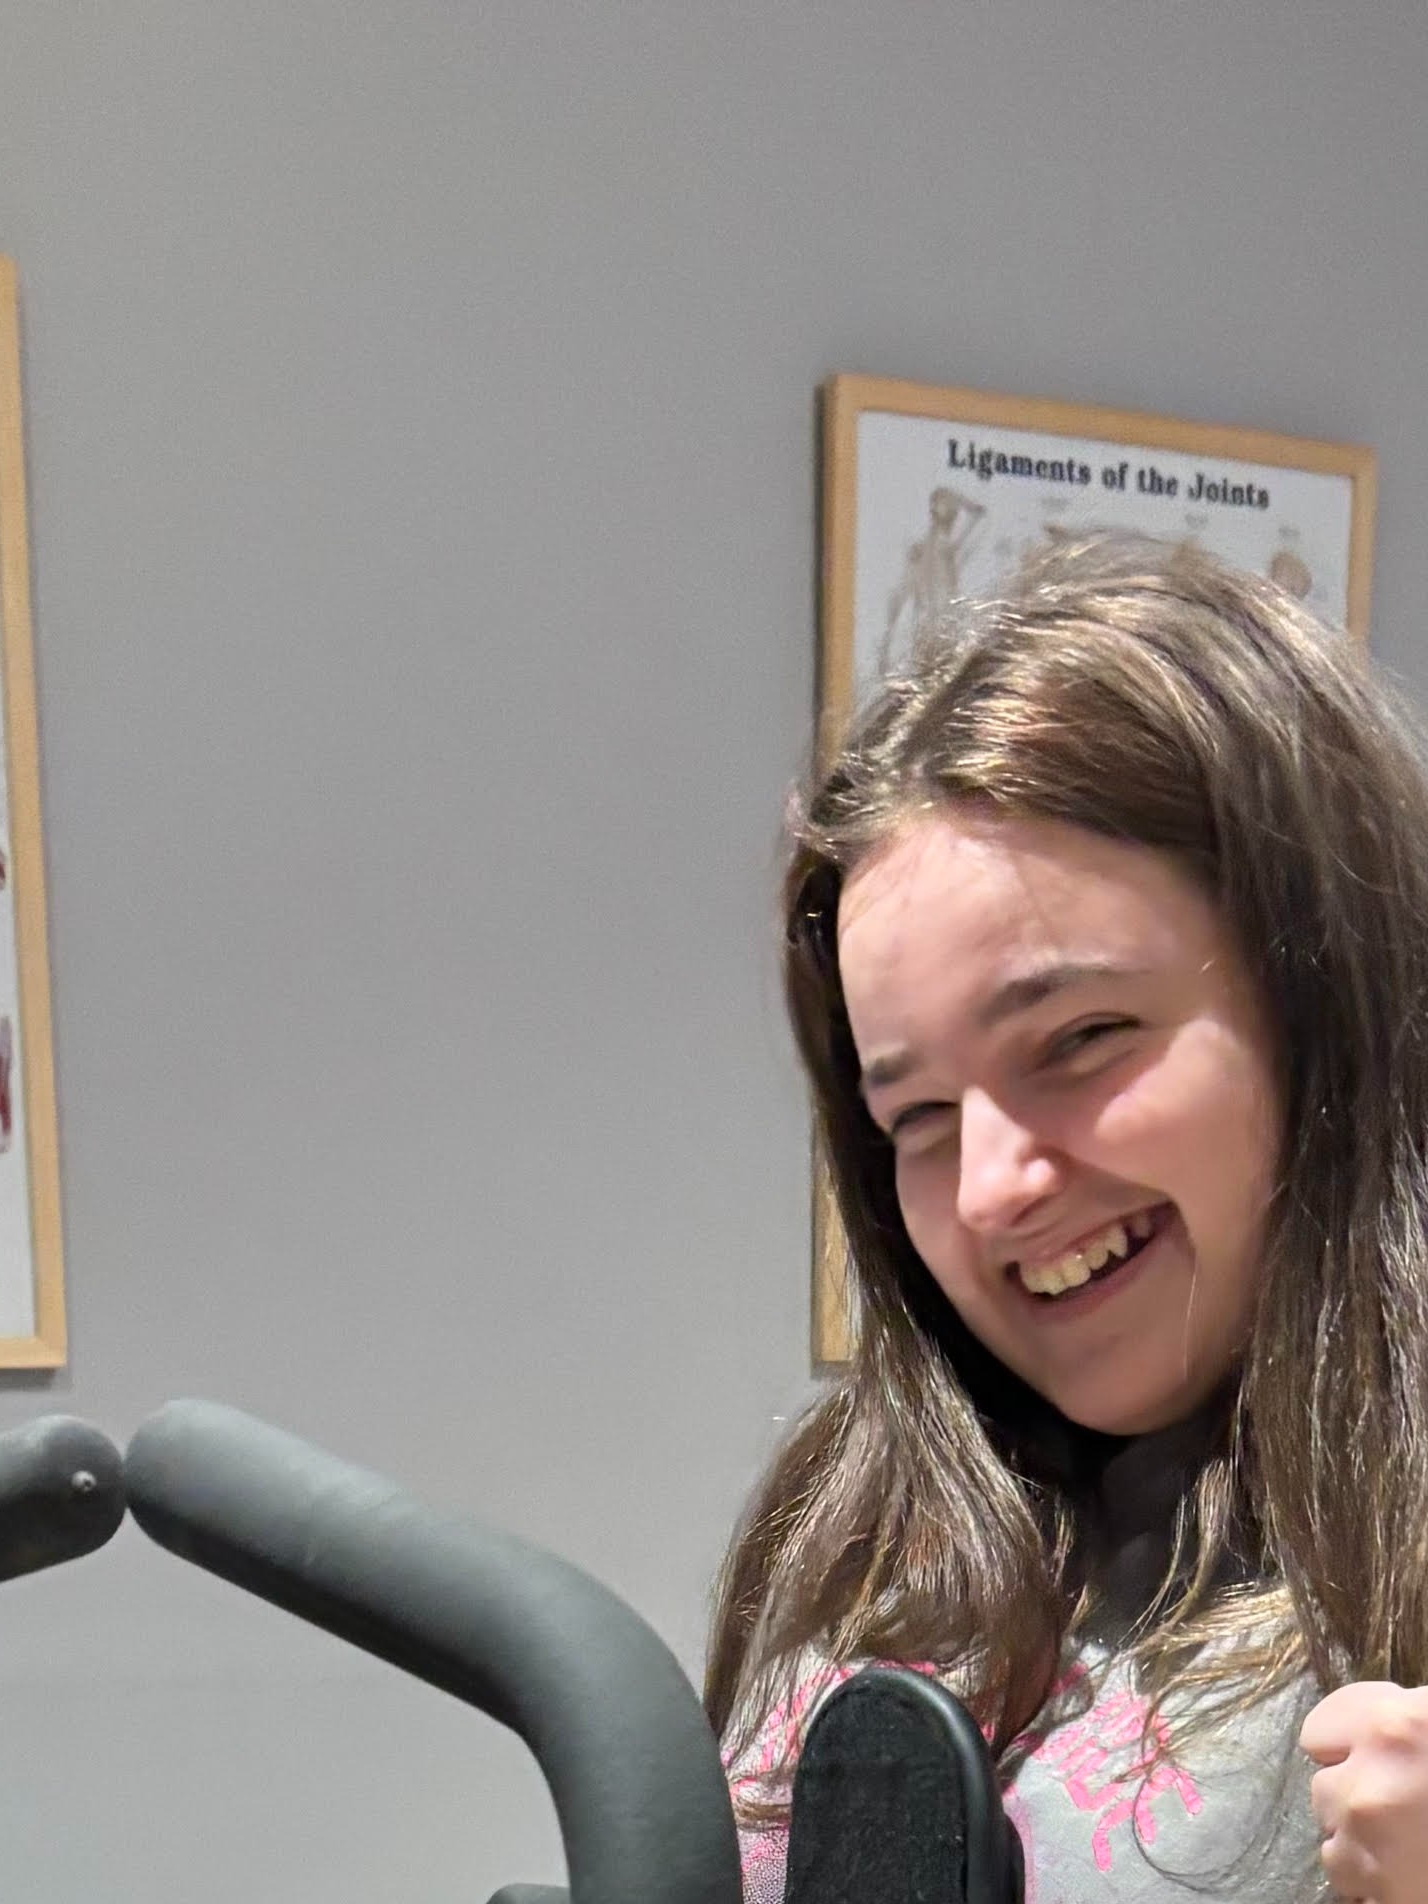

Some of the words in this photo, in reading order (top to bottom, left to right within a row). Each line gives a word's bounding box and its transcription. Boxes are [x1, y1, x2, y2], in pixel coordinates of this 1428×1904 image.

[947, 438, 1091, 485] Ligaments
[1101, 461, 1129, 491] of
[1137, 466, 1178, 498] the
[1188, 472, 1270, 510] Joints
